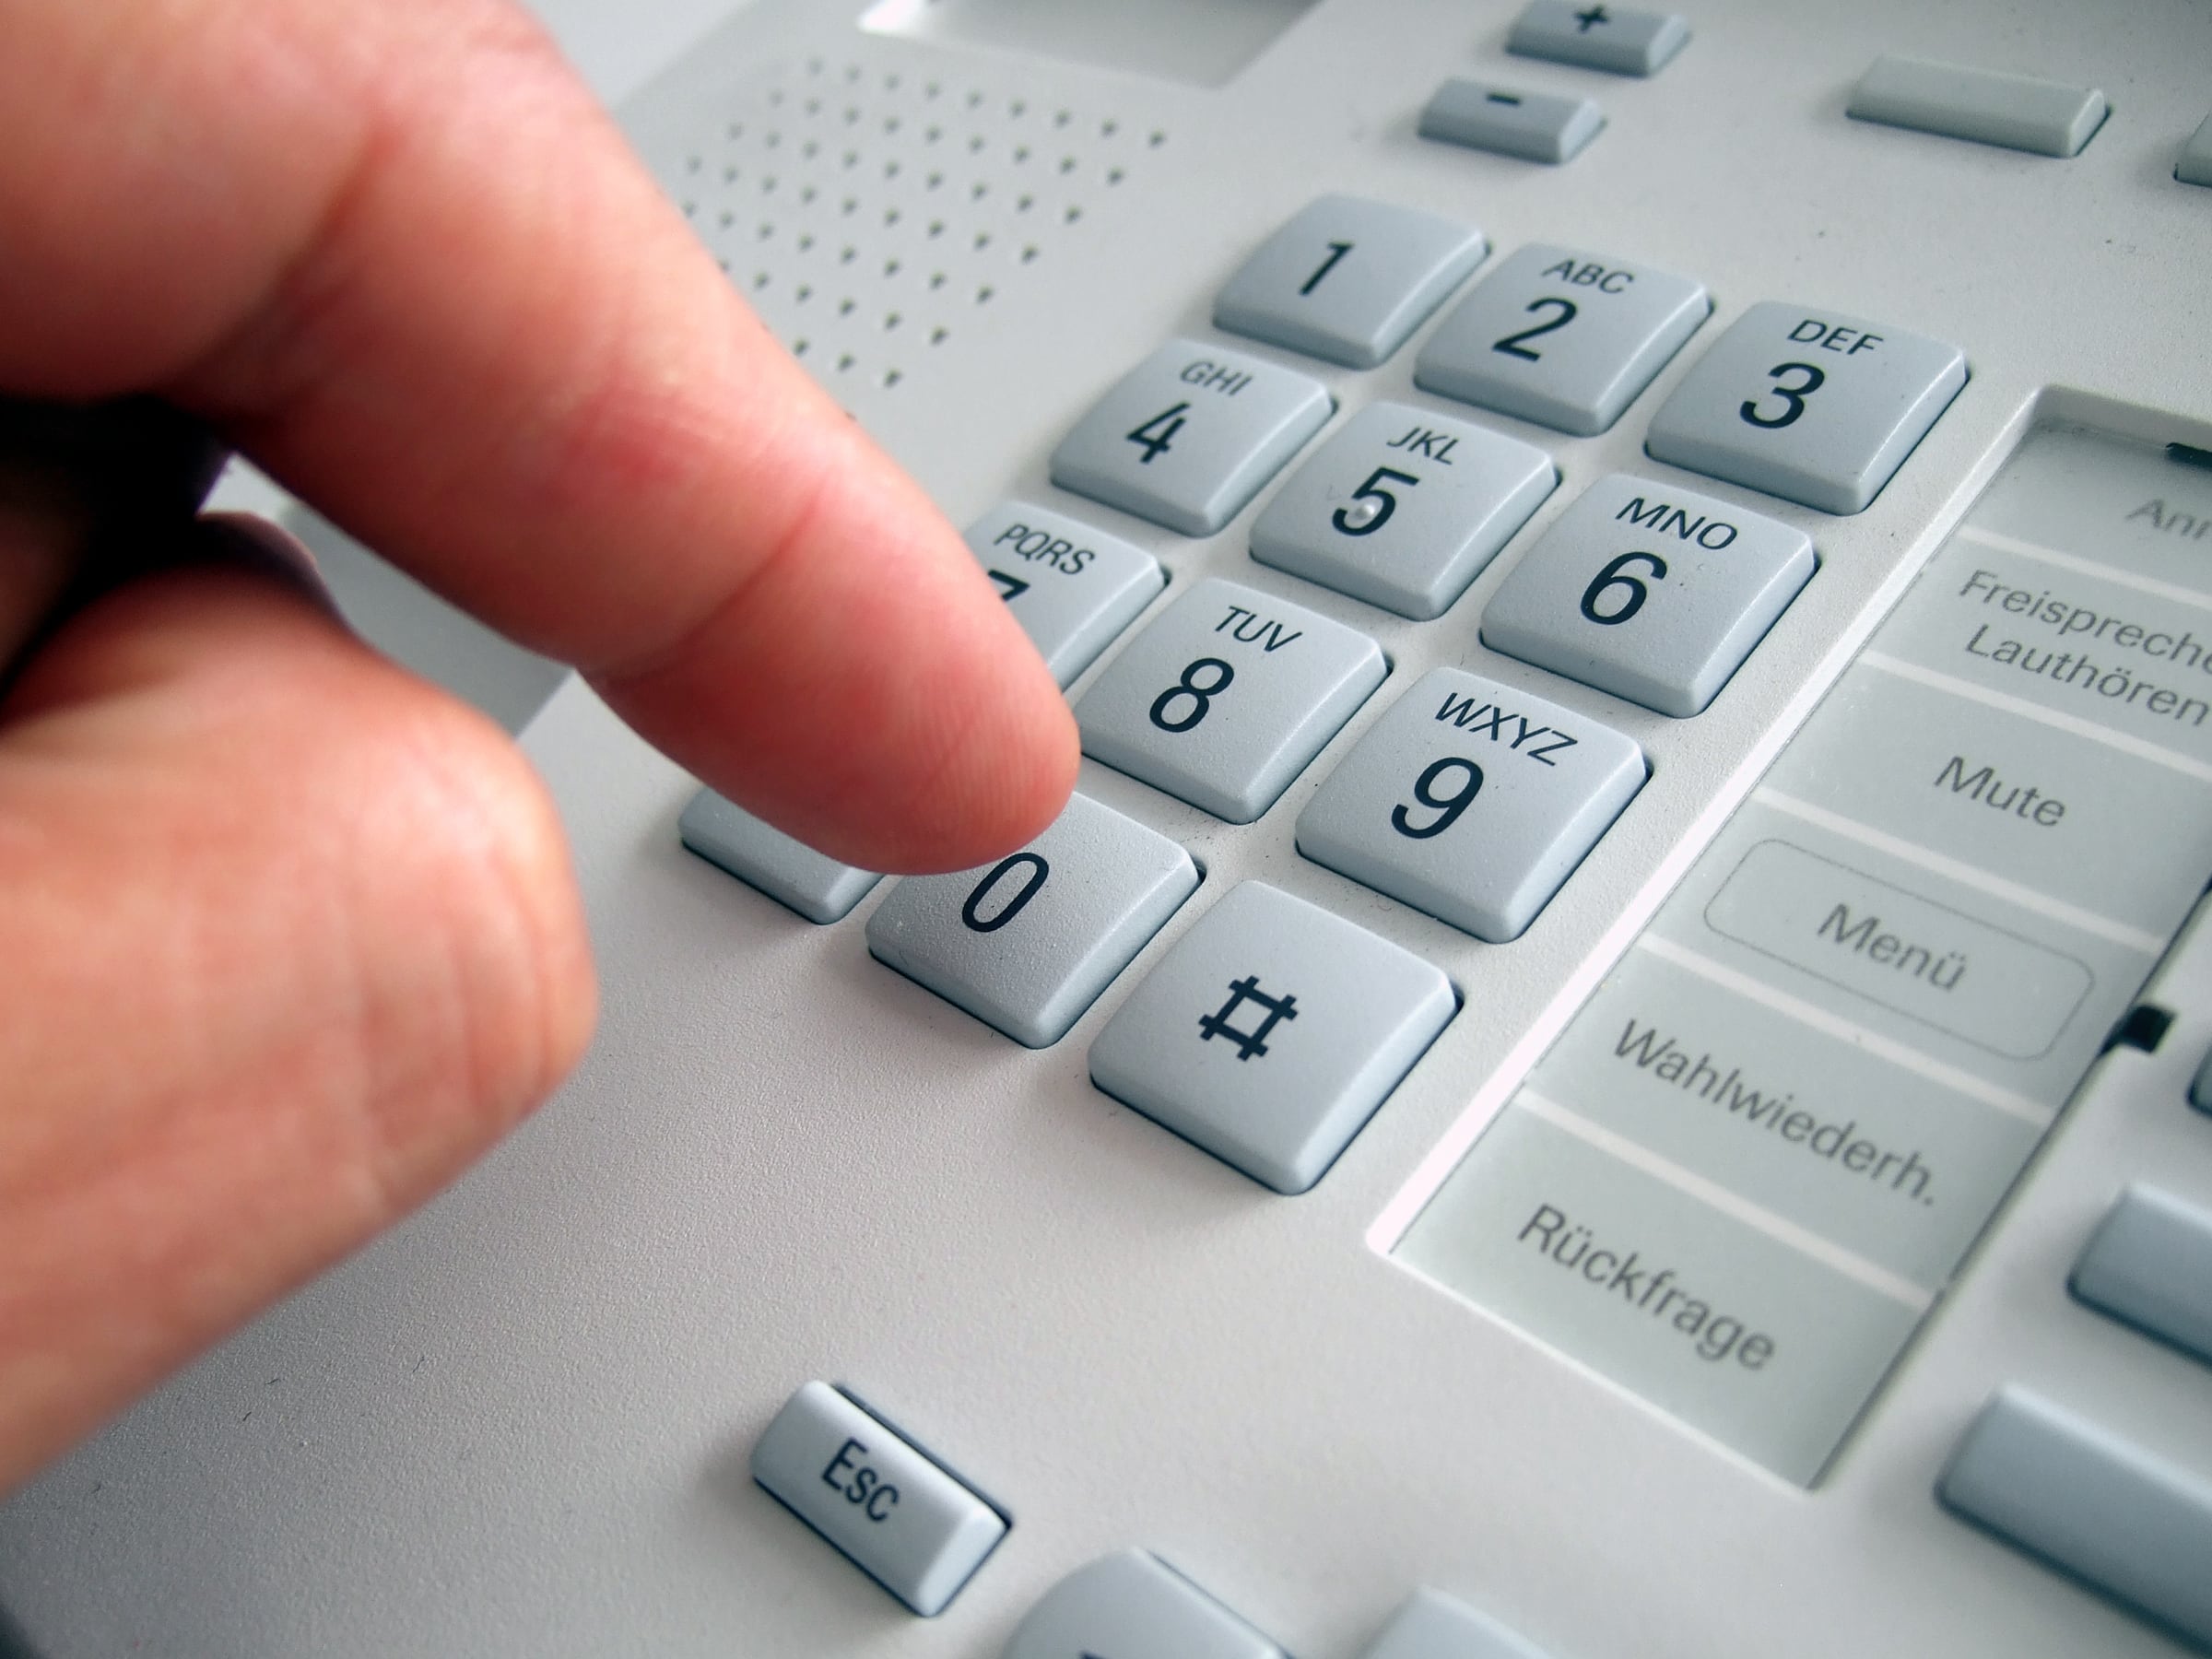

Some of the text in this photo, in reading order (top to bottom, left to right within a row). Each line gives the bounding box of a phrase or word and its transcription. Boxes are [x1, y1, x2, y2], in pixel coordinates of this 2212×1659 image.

[1299, 242, 1353, 297] 1
[1541, 259, 1635, 295] ABC
[1491, 297, 1578, 362] 2
[1787, 319, 1884, 357] DEF
[1179, 360, 1253, 396] GHI
[1739, 362, 1826, 429] 3
[1125, 402, 1191, 465] 4
[1385, 427, 1459, 465] JKL
[1331, 466, 1419, 537] 5
[1615, 497, 1738, 551] MNO
[993, 524, 1097, 576] PQRS
[1580, 551, 1668, 626] 6
[1214, 606, 1303, 653] TUV
[1148, 657, 1235, 734] 8
[1965, 623, 2211, 727] Lauthören
[1434, 692, 1578, 767] WXYZ
[1391, 757, 1484, 840] 9
[1934, 756, 2066, 828] Mute
[961, 852, 1050, 934] 0
[1817, 903, 1968, 993] Menü
[1614, 1018, 1936, 1207] Wahlwiederh.
[1516, 1203, 1777, 1372] Rückfrage
[821, 1437, 900, 1523] Esc
